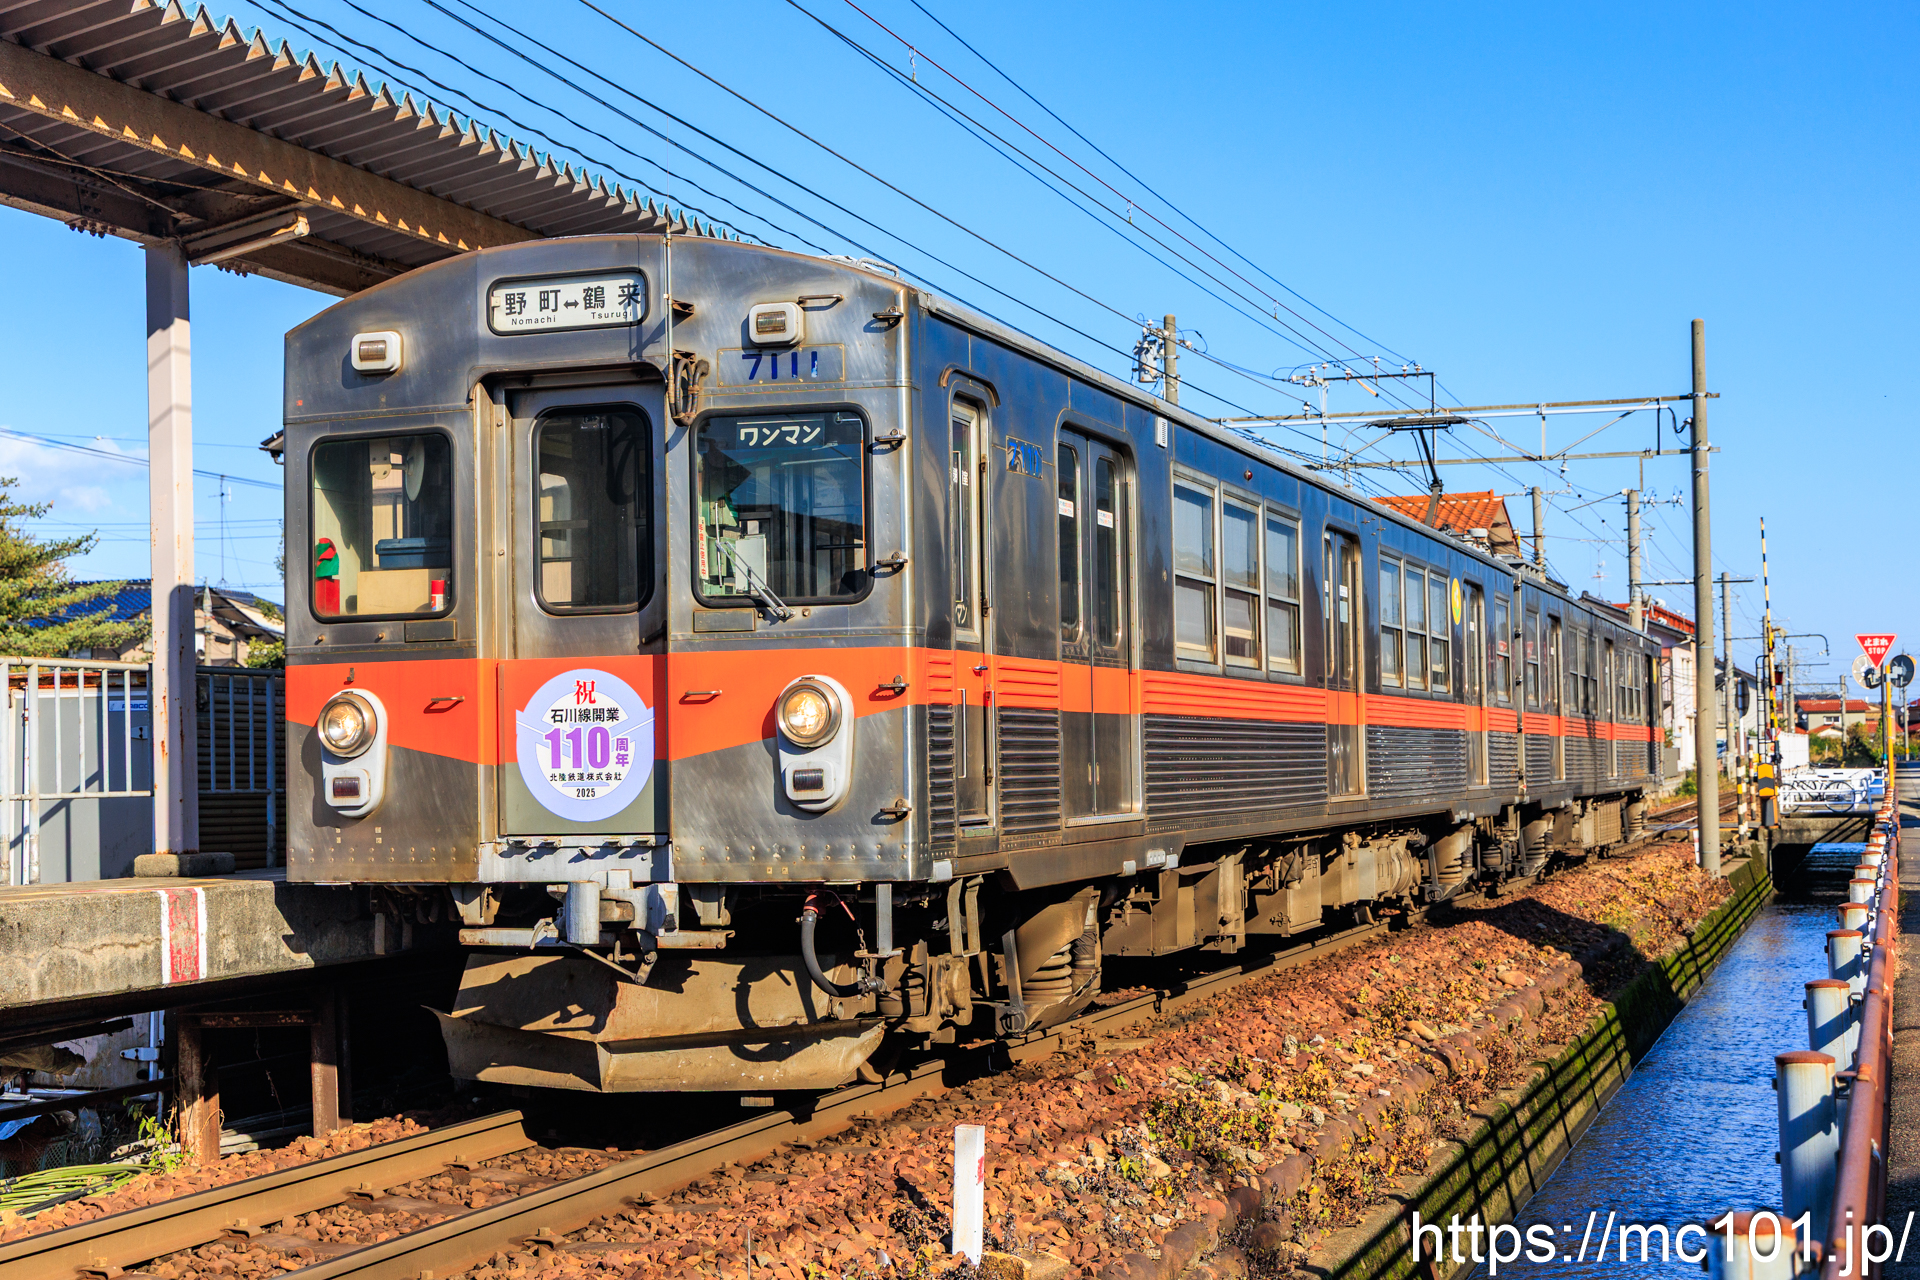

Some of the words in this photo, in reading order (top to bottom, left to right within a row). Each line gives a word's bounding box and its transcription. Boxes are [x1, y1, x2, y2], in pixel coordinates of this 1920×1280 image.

[505, 290, 561, 316] 野町
[582, 283, 641, 310] 鶴来
[511, 315, 556, 325] Nomachi
[591, 311, 632, 320] Tsurugi
[742, 351, 818, 381] 7111
[740, 425, 821, 446] ワンマン
[1009, 442, 1039, 473] 7111
[1863, 637, 1889, 647] 止まれ
[1868, 647, 1886, 655] STOP
[573, 680, 597, 705] 祝
[550, 707, 620, 724] 石川線開業
[544, 726, 610, 769] 110
[615, 737, 630, 768] 周年
[550, 772, 622, 782] 北陸鉄道株式会社
[576, 788, 596, 798] 2025
